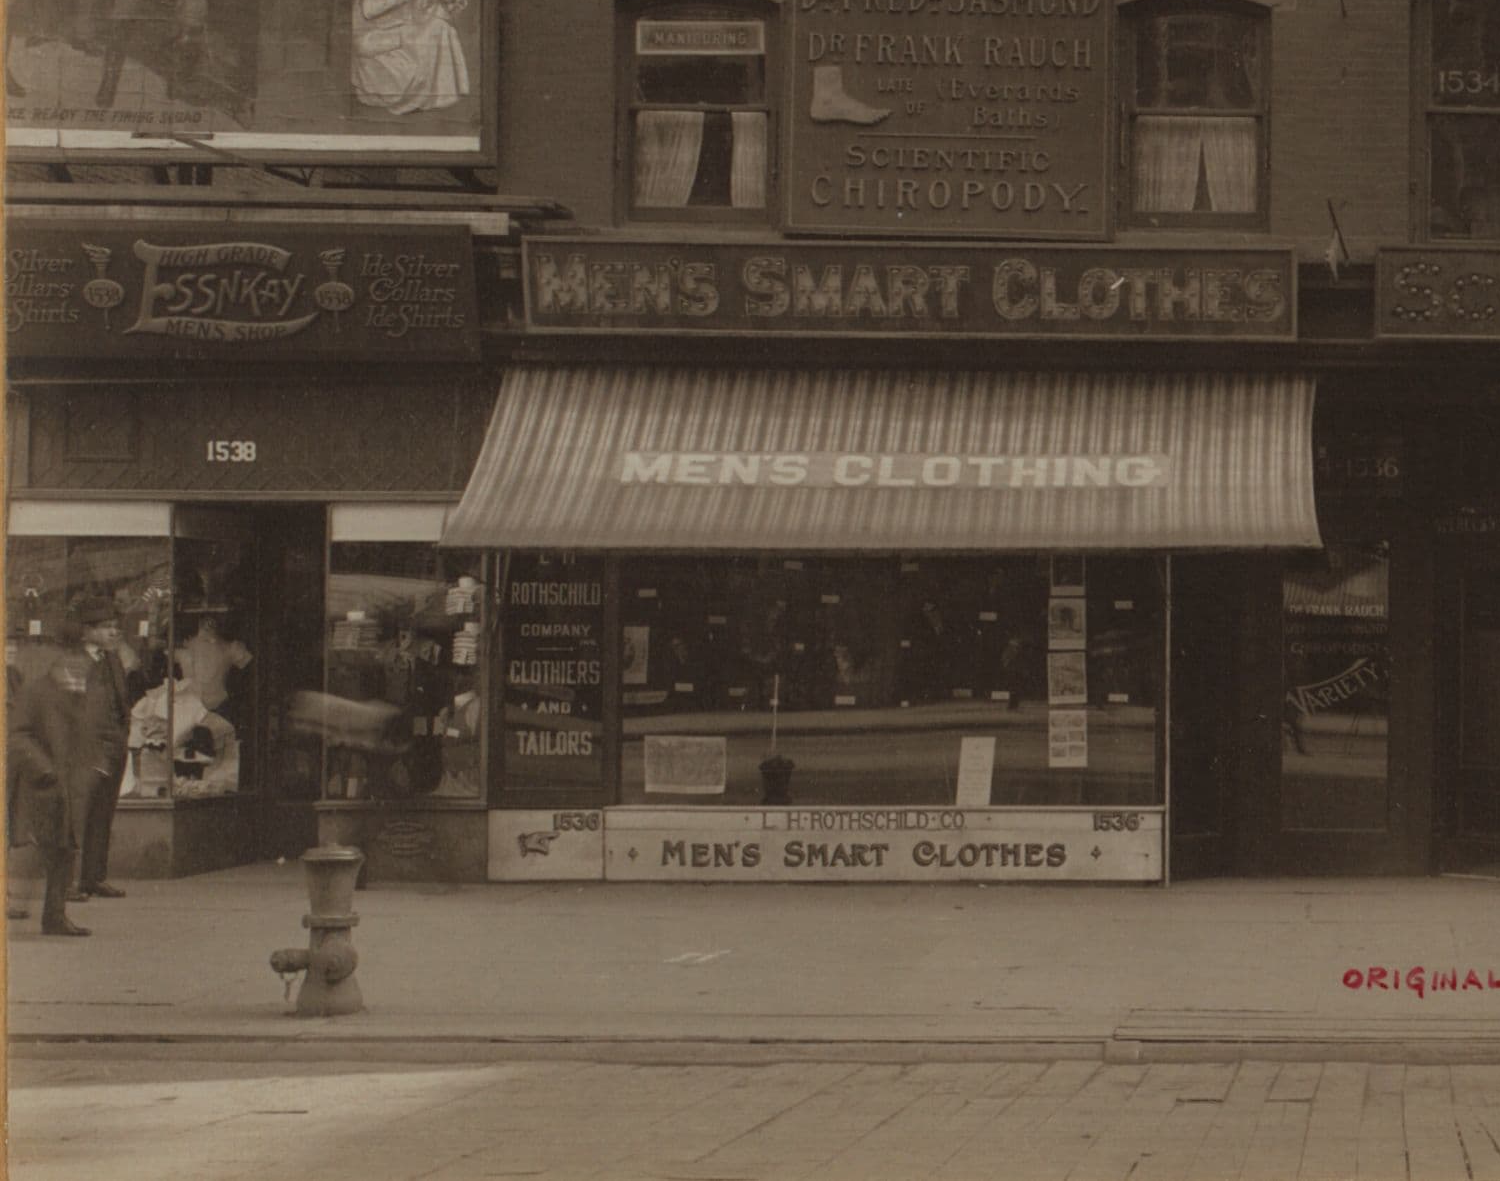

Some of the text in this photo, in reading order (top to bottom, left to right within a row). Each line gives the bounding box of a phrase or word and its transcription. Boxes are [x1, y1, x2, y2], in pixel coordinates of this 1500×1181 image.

[854, 33, 963, 67] FRANK
[983, 35, 1093, 70] RAUCH
[1438, 69, 1500, 95] 1534
[846, 145, 1051, 173] SCIENTIFIC
[161, 247, 282, 268] HIGH GRADE
[361, 253, 460, 288] Ide Silver
[369, 277, 457, 301] Collars
[535, 251, 1288, 324] MEN'S SMART CLOTHES
[238, 323, 287, 341] SHOP
[387, 304, 466, 337] Shirts
[206, 440, 257, 462] 1538
[620, 451, 1163, 488] MEN'S CLOTHING
[510, 581, 601, 606] ROTHSCHILD
[519, 623, 592, 637] COMPANY
[509, 660, 600, 686] CLOTHIERS
[1286, 658, 1379, 719] VARIETY
[537, 700, 572, 715] AND
[515, 729, 593, 756] TAILORS
[552, 811, 600, 832] 1536
[1092, 812, 1142, 832] 1536
[660, 839, 1068, 868] MEN'S SMART CLOTHES
